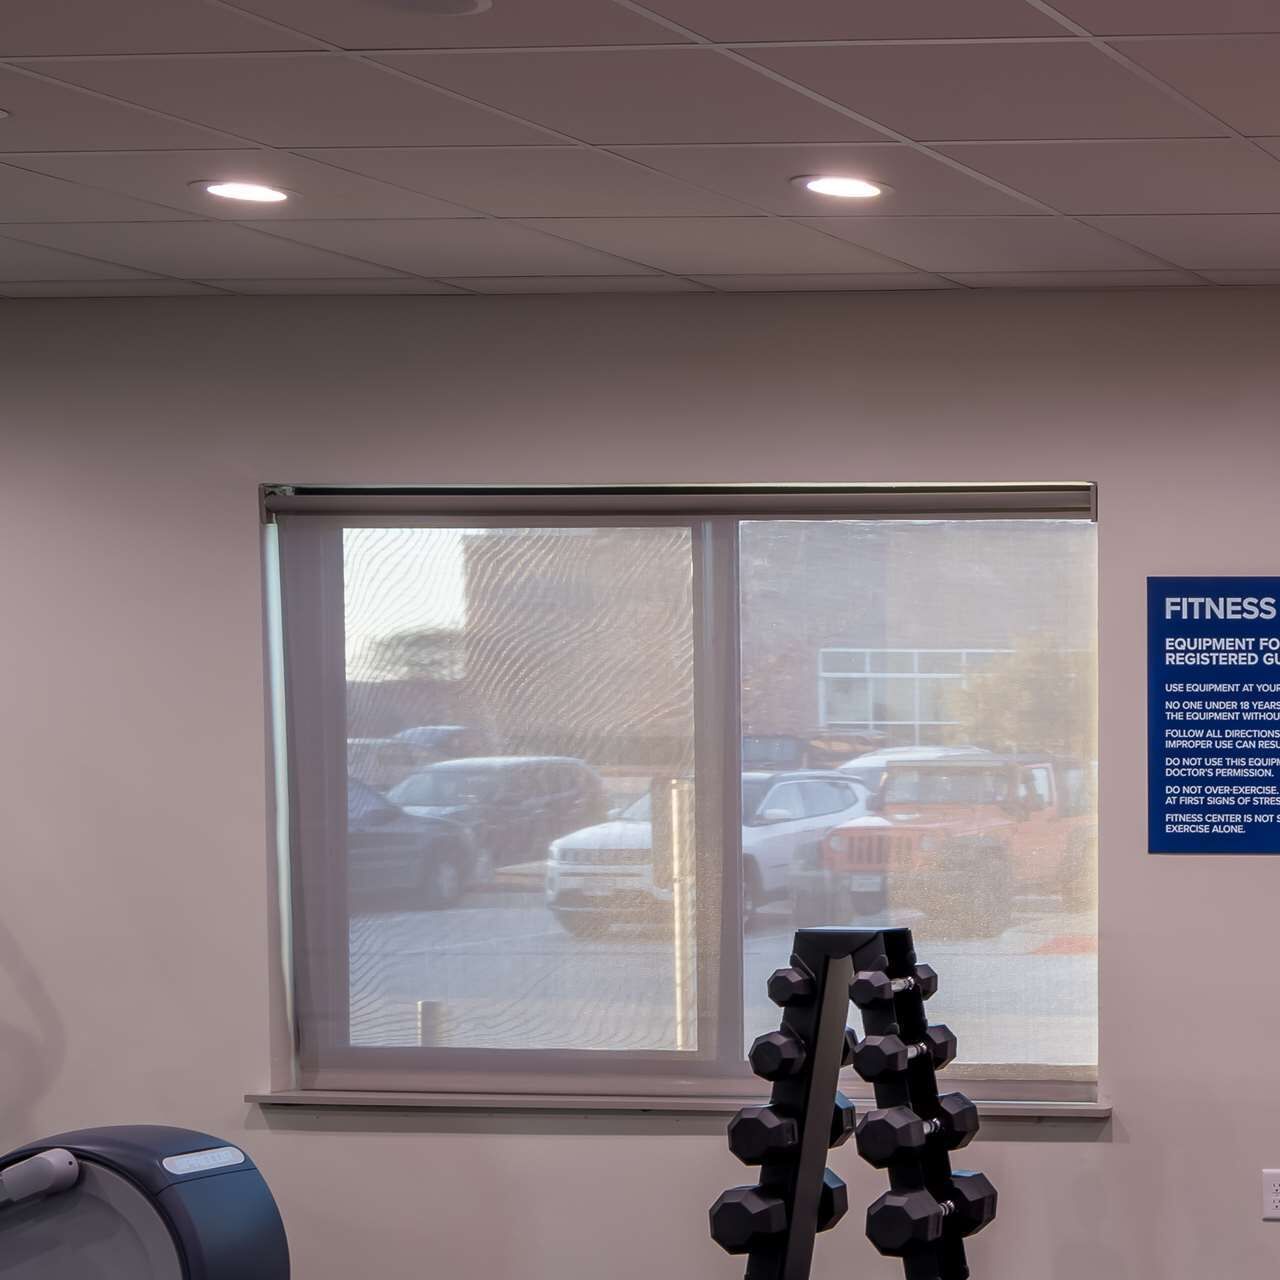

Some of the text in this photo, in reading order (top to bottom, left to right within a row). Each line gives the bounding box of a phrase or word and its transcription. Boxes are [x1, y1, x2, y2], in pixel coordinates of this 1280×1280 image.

[1165, 596, 1277, 620] FITNESS
[1165, 637, 1256, 651] EQUIPMENT
[1165, 652, 1259, 666] REGISTERED
[1165, 682, 1185, 693] USE
[1185, 682, 1241, 693] EQUIPMENT
[1241, 682, 1255, 693] AT
[1165, 700, 1181, 711] NO
[1182, 700, 1203, 711] ONE
[1204, 700, 1238, 711] UNDER
[1239, 700, 1250, 711] 18
[1165, 711, 1184, 721] THE
[1185, 711, 1241, 721] EQUIPMENT
[1165, 728, 1205, 739] FOLLOW
[1205, 728, 1223, 739] ALL
[1224, 728, 1280, 739] DIRECTIONS
[1165, 739, 1213, 750] IMPROPER
[1214, 739, 1234, 750] USE
[1235, 739, 1256, 750] CAN
[1165, 757, 1181, 767] DO
[1182, 757, 1203, 767] NOT
[1204, 757, 1224, 767] USE
[1224, 757, 1247, 767] THIS
[1165, 767, 1275, 778] DOCTOR'S PERMISSION.
[1165, 785, 1181, 796] DO
[1182, 785, 1203, 796] NOT
[1204, 785, 1280, 796] OVER-EXERCISE.
[1165, 795, 1178, 806] AT
[1179, 795, 1205, 806] FIRST
[1206, 795, 1236, 806] SIGNS
[1236, 795, 1251, 806] OF
[1165, 813, 1204, 824] FITNESS
[1204, 813, 1242, 824] CENTER
[1243, 813, 1253, 824] IS
[1254, 813, 1275, 824] NOT
[1165, 824, 1246, 834] EXERCISE ALONE.
